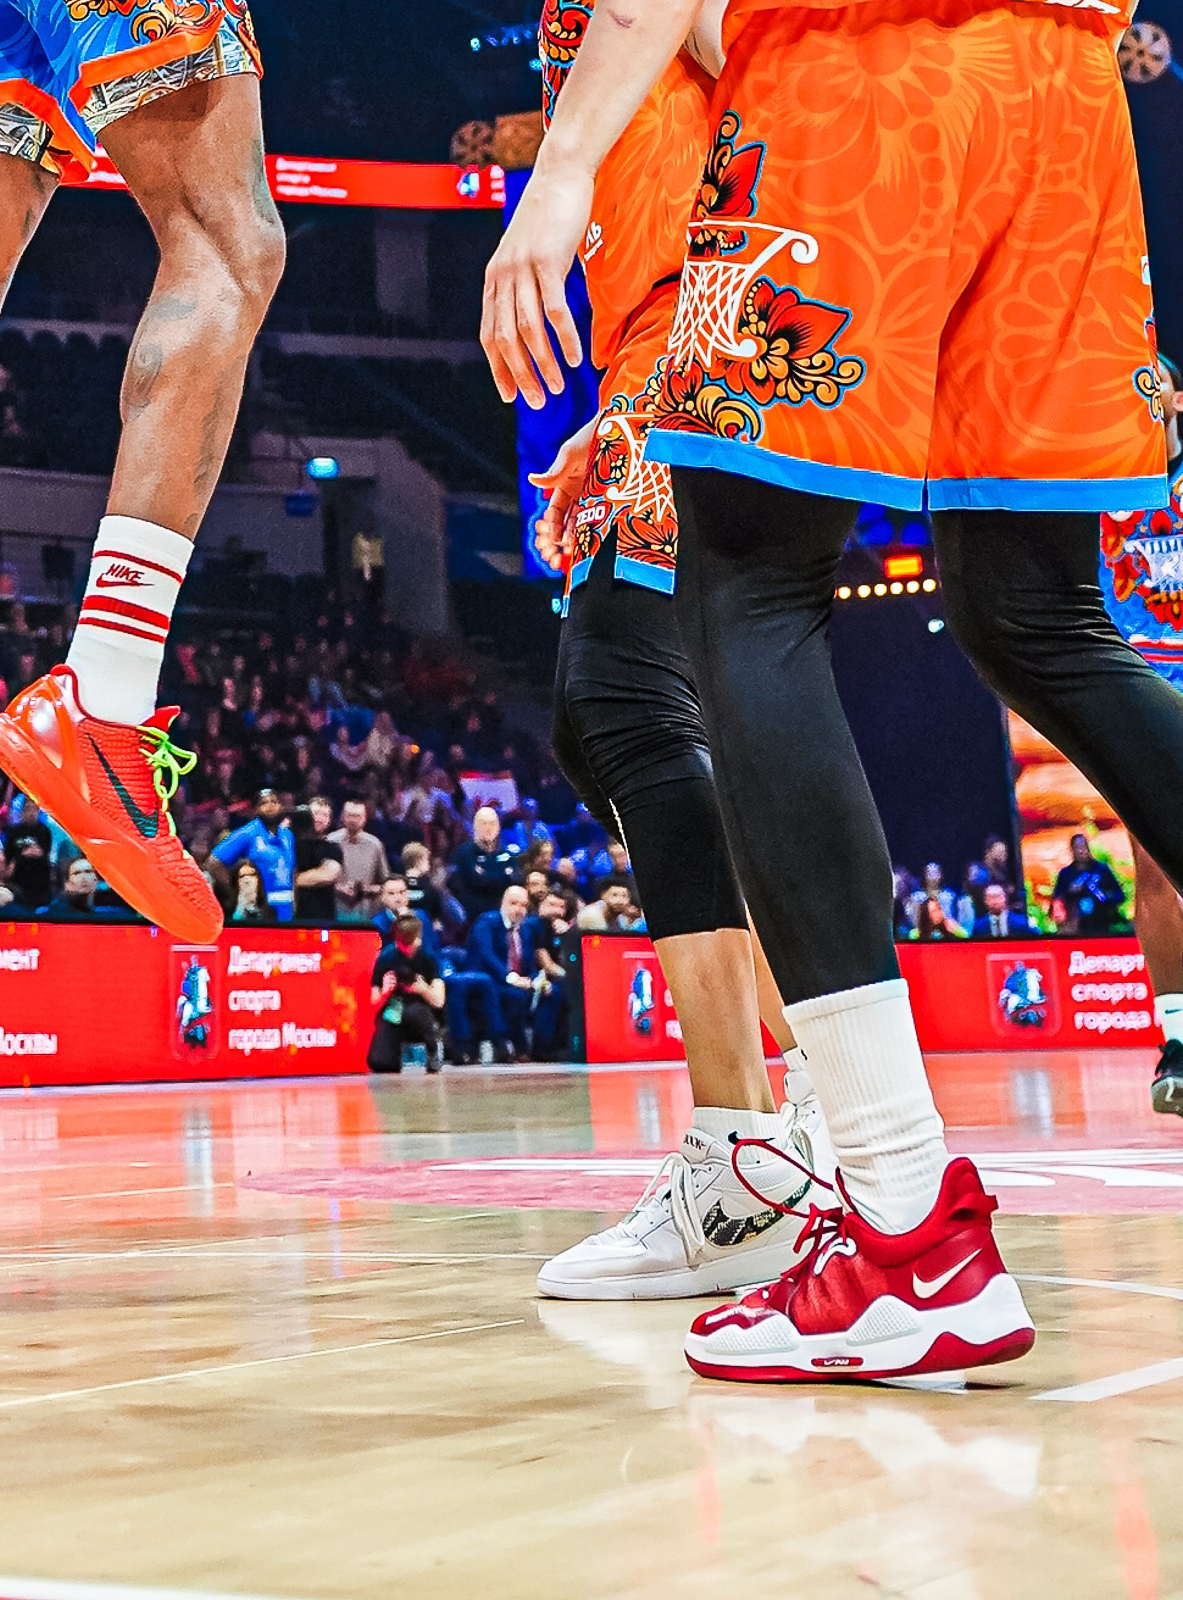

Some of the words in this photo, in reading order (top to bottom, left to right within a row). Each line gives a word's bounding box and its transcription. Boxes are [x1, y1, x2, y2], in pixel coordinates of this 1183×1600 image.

[106, 563, 145, 584] NIKE
[1068, 950, 1145, 977] Департ
[1071, 982, 1148, 1005] спорта
[1074, 1010, 1152, 1035] города
